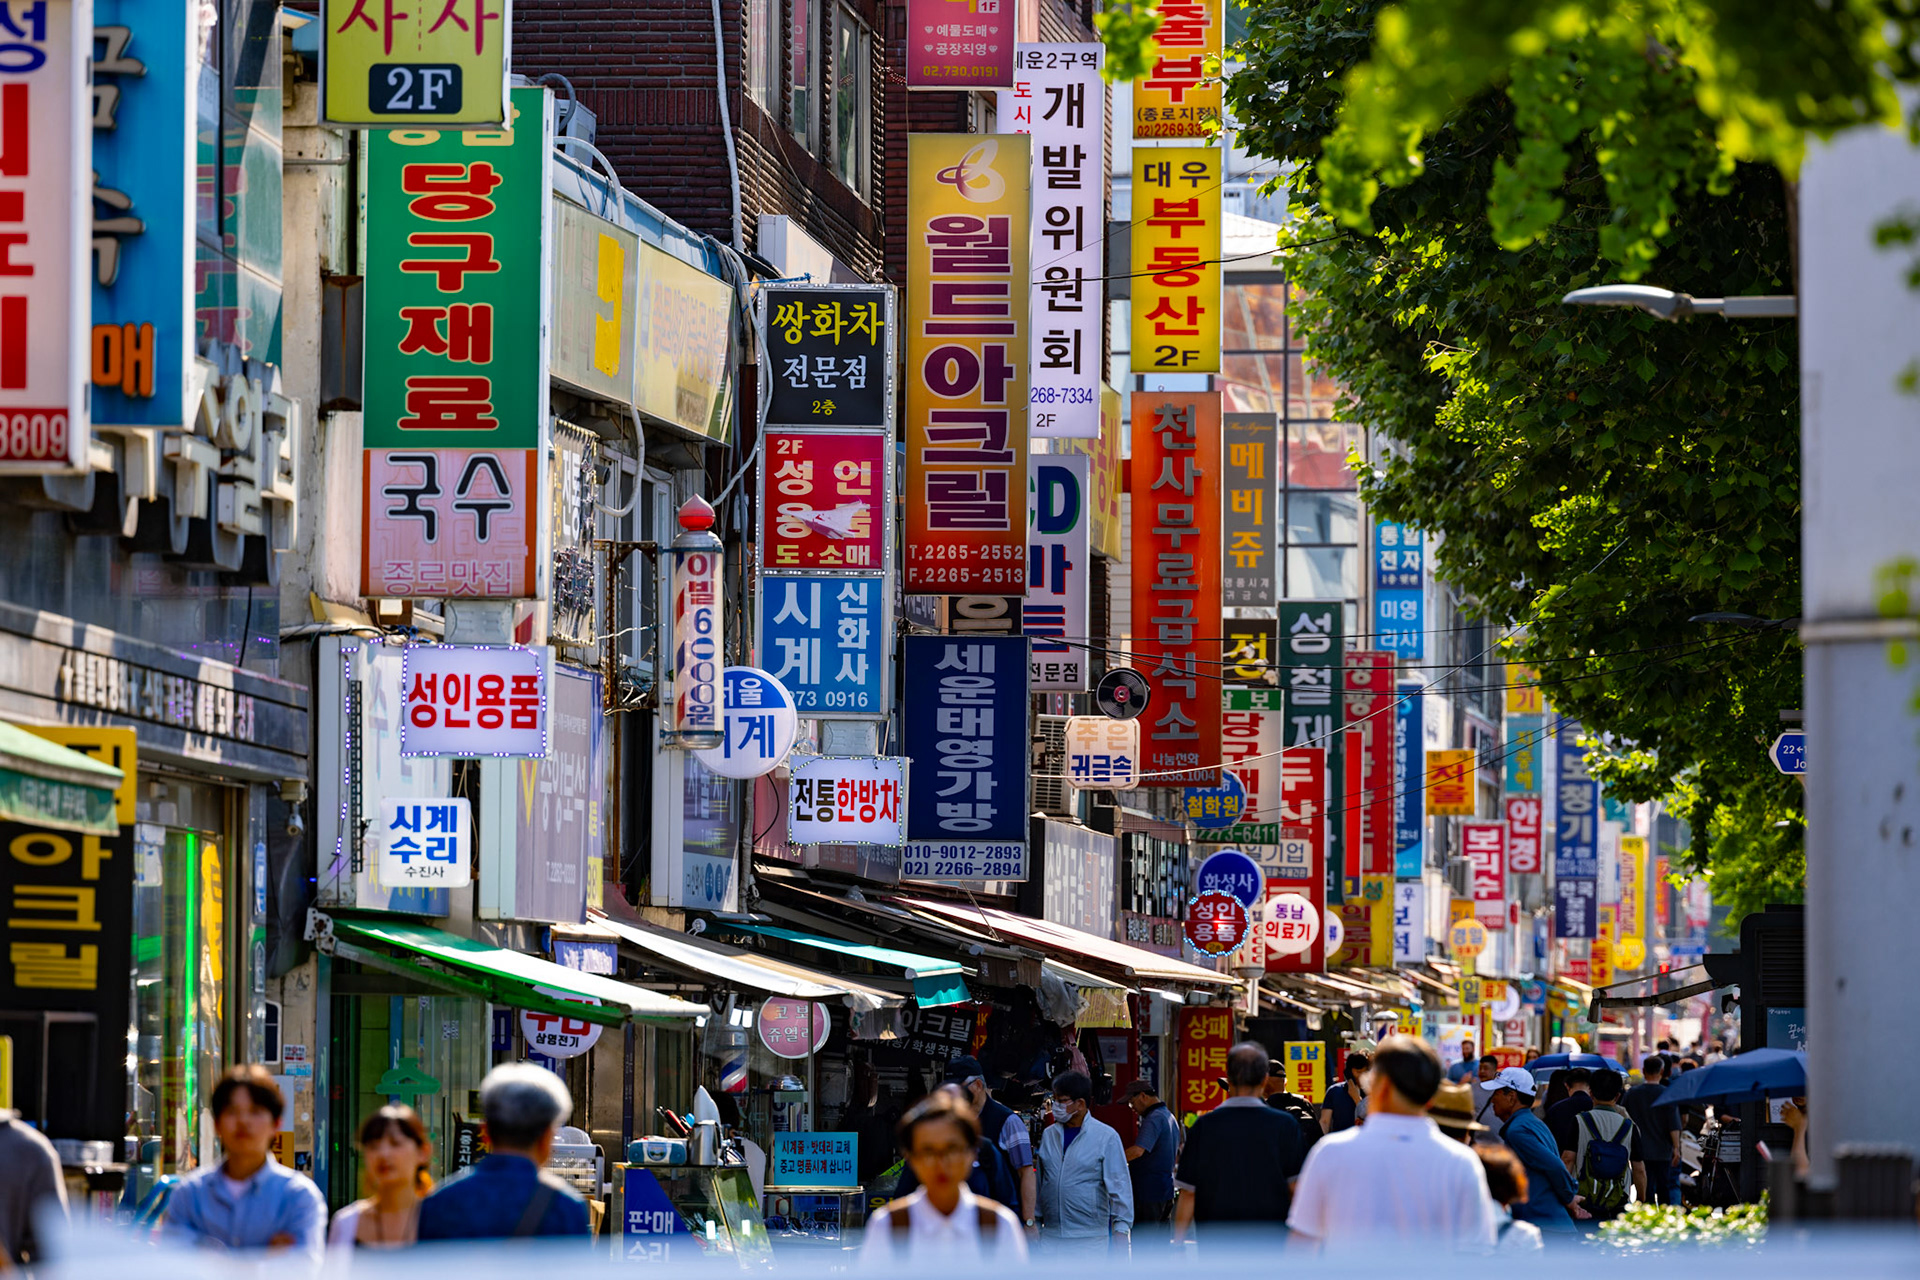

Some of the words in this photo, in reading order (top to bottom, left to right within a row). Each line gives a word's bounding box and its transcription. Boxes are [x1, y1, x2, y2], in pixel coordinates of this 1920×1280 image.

[981, 2, 996, 11] 1F
[936, 25, 987, 37] 예물도매
[936, 43, 987, 56] 공장직영
[385, 67, 453, 111] 2F
[1013, 82, 1032, 133] 도시
[1144, 161, 1210, 188] 대우
[1040, 83, 1087, 374] 개발위원회
[1145, 199, 1206, 336] 부동산
[398, 161, 502, 430] 당구재료
[771, 301, 884, 345] 쌍화차
[1154, 345, 1200, 366] 2F
[782, 354, 867, 389] 전문점
[922, 214, 1017, 531] 월드아크릴
[812, 400, 836, 416] 2층
[1036, 414, 1056, 427] 2F
[777, 440, 803, 455] 2F
[381, 452, 514, 544] 국수
[1229, 442, 1265, 568] 메비쥬
[909, 545, 1023, 560] T.2265-2552
[1380, 550, 1421, 572] 전자
[383, 560, 512, 595] 종로맛집
[1151, 403, 1201, 740] 천사무료급식소
[1381, 600, 1418, 621] 미영
[773, 582, 821, 685] 시계
[835, 583, 870, 685] 신화사
[409, 673, 539, 730] 성인용품
[825, 691, 868, 707] 0916
[1077, 723, 1128, 750] 주은
[1153, 753, 1200, 766] 나눔전화
[1783, 745, 1795, 754] 22
[1071, 754, 1132, 782] 귀금속
[794, 778, 899, 823] 전통한방차
[1187, 795, 1239, 818] 철학원
[389, 805, 458, 833] 시계
[1510, 801, 1540, 871] 안경
[389, 836, 458, 863] 수리
[904, 845, 1022, 860] 010-9012-2893
[404, 866, 445, 878] 수진사
[904, 861, 928, 877] 02)
[934, 861, 1022, 876] 2266-2894
[1467, 829, 1500, 897] 보리수
[1204, 873, 1254, 893] 화성사
[8, 833, 113, 989] 아크릴
[1195, 902, 1235, 920] 성인
[1276, 904, 1304, 919] 동남
[1194, 923, 1236, 941] 용품
[1266, 921, 1310, 940] 의료기
[902, 1010, 971, 1042] 아크릴
[1188, 1015, 1228, 1040] 상패
[536, 1033, 579, 1047] 삼영전기
[1188, 1047, 1227, 1071] 바둑
[1290, 1046, 1320, 1060] 동남
[782, 1141, 805, 1154] 시계줄
[836, 1141, 851, 1154] 교체
[780, 1160, 795, 1174] 중고
[797, 1160, 827, 1174] 명품시계
[829, 1160, 852, 1174] 삽니다
[628, 1210, 674, 1235] 판매
